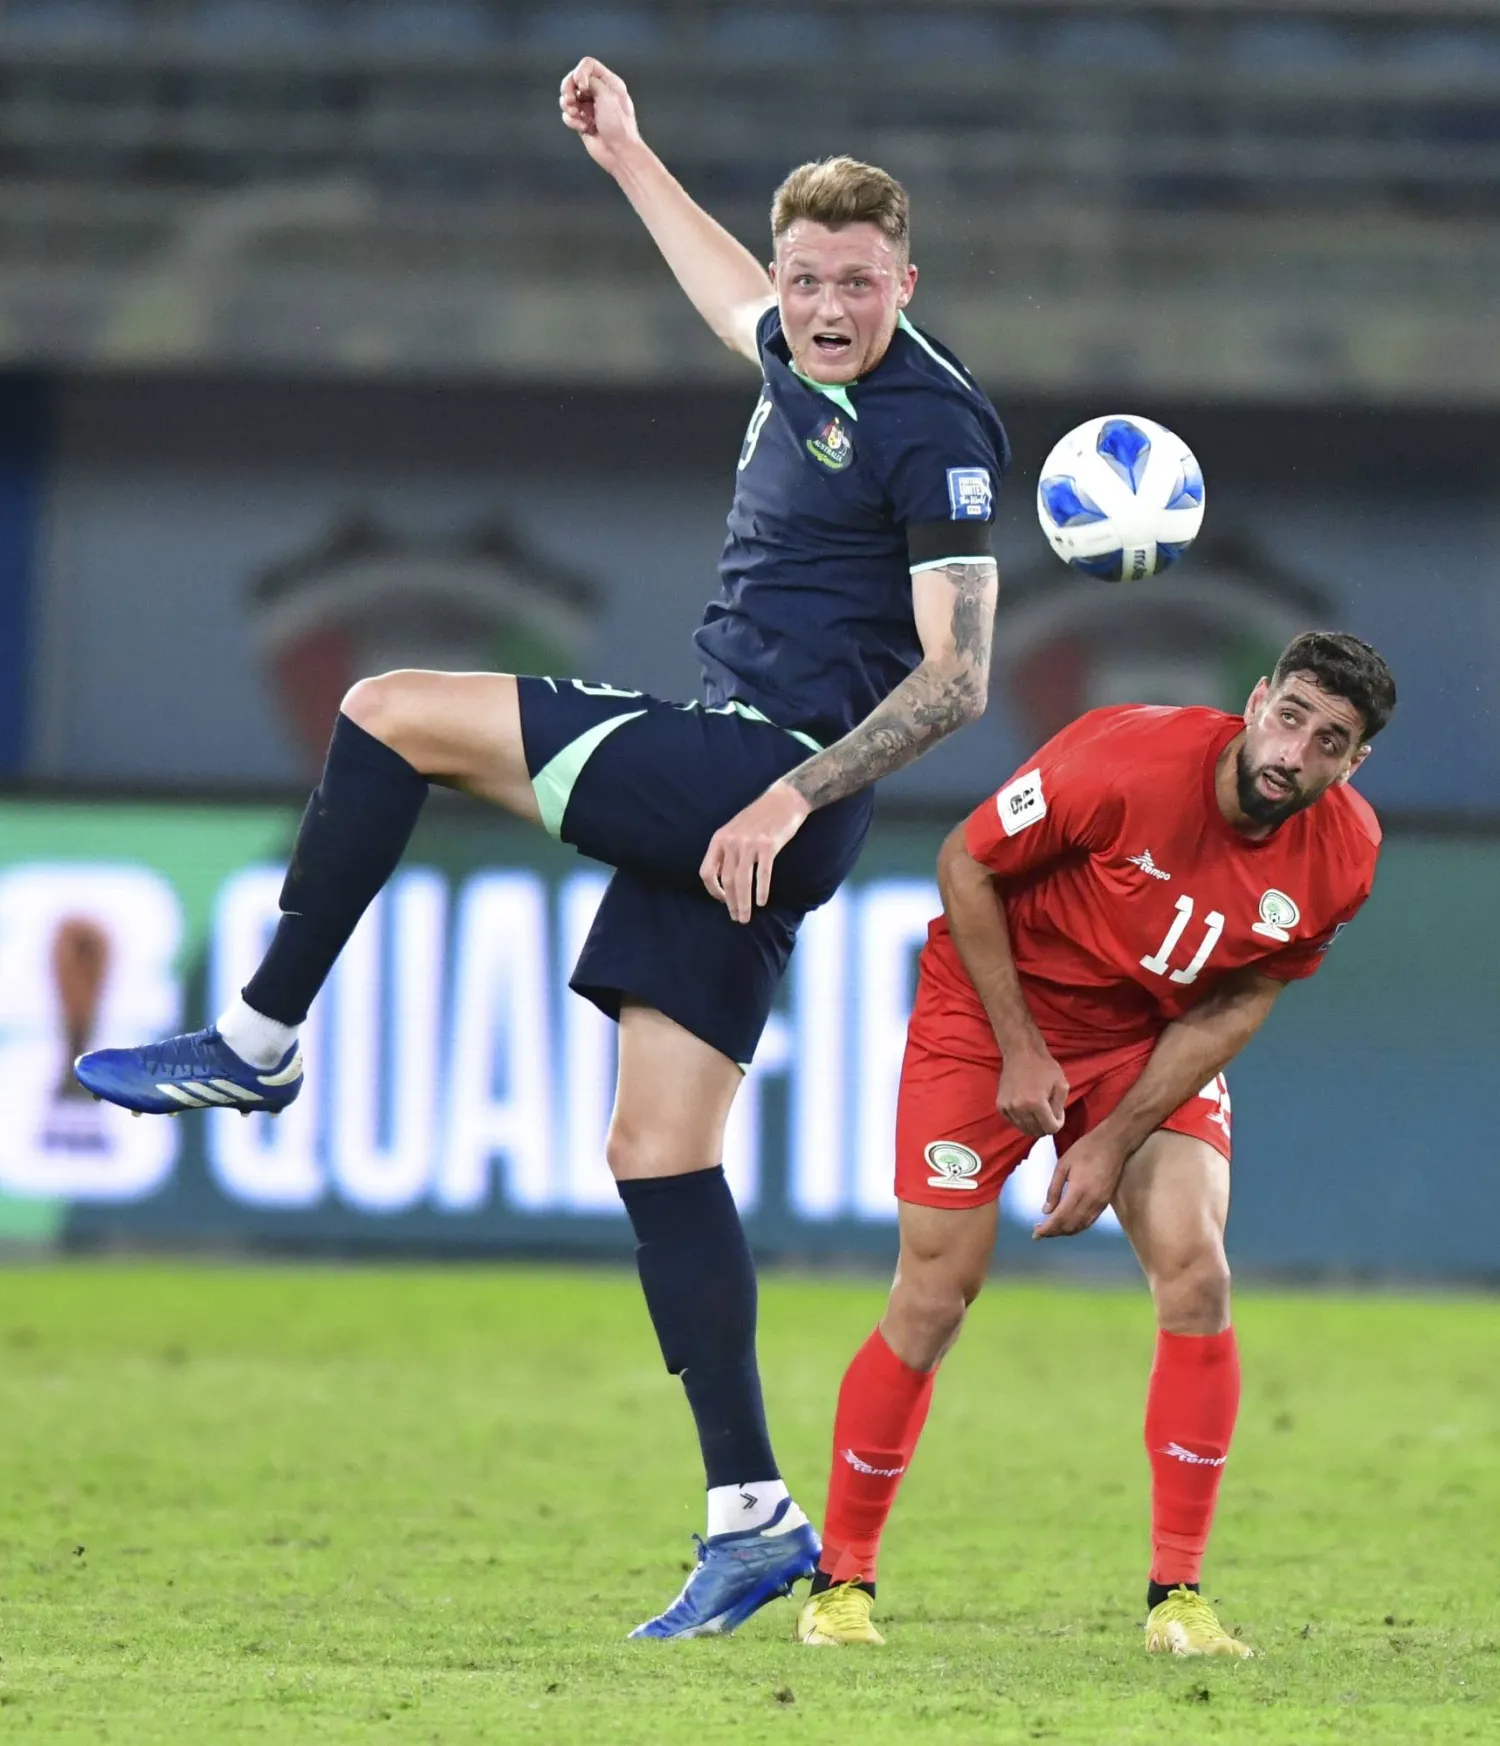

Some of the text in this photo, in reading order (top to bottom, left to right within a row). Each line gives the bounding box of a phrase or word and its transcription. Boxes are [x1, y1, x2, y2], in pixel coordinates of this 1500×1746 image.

[812, 438, 844, 463] AUSTRALIA
[1139, 861, 1171, 881] tempo
[1139, 894, 1225, 985] 11
